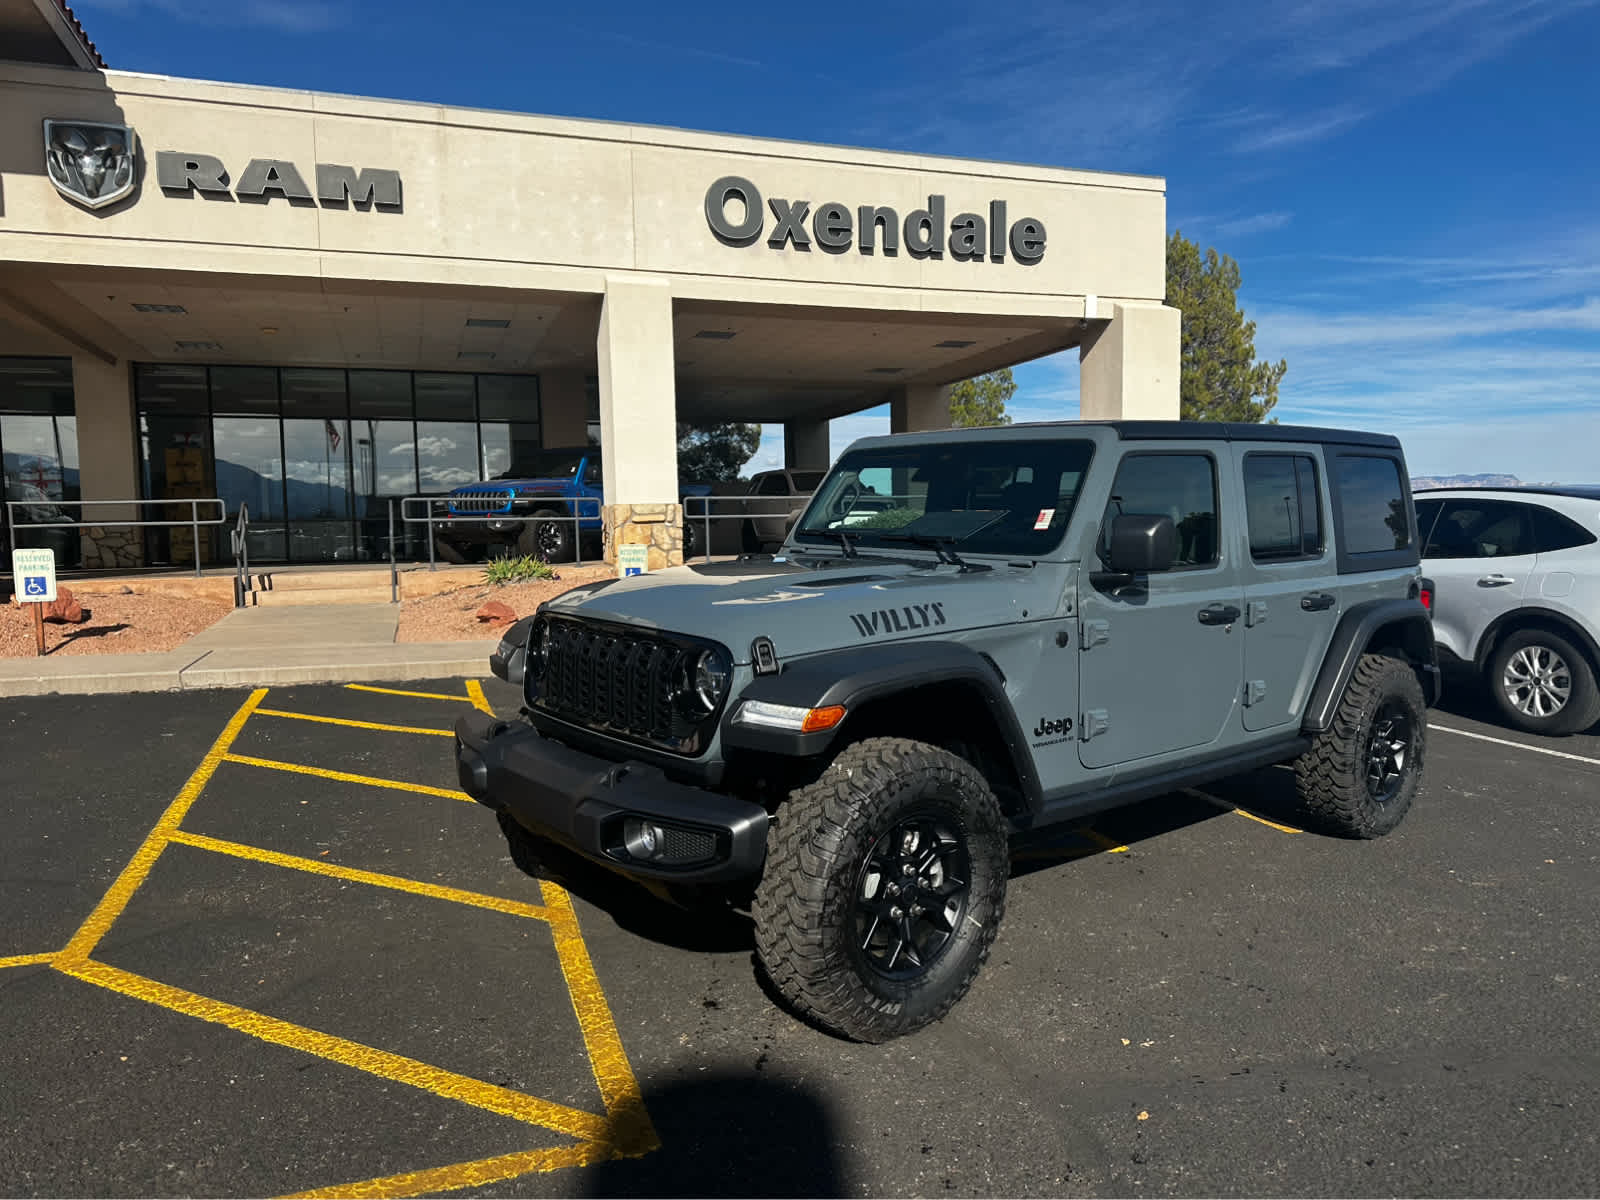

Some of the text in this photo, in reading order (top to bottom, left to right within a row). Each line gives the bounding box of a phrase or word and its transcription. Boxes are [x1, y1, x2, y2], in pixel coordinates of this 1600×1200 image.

[155, 151, 403, 214] RAM
[704, 175, 1047, 265] Oxendale
[849, 602, 946, 637] WILLYS
[1033, 717, 1072, 736] Jeep
